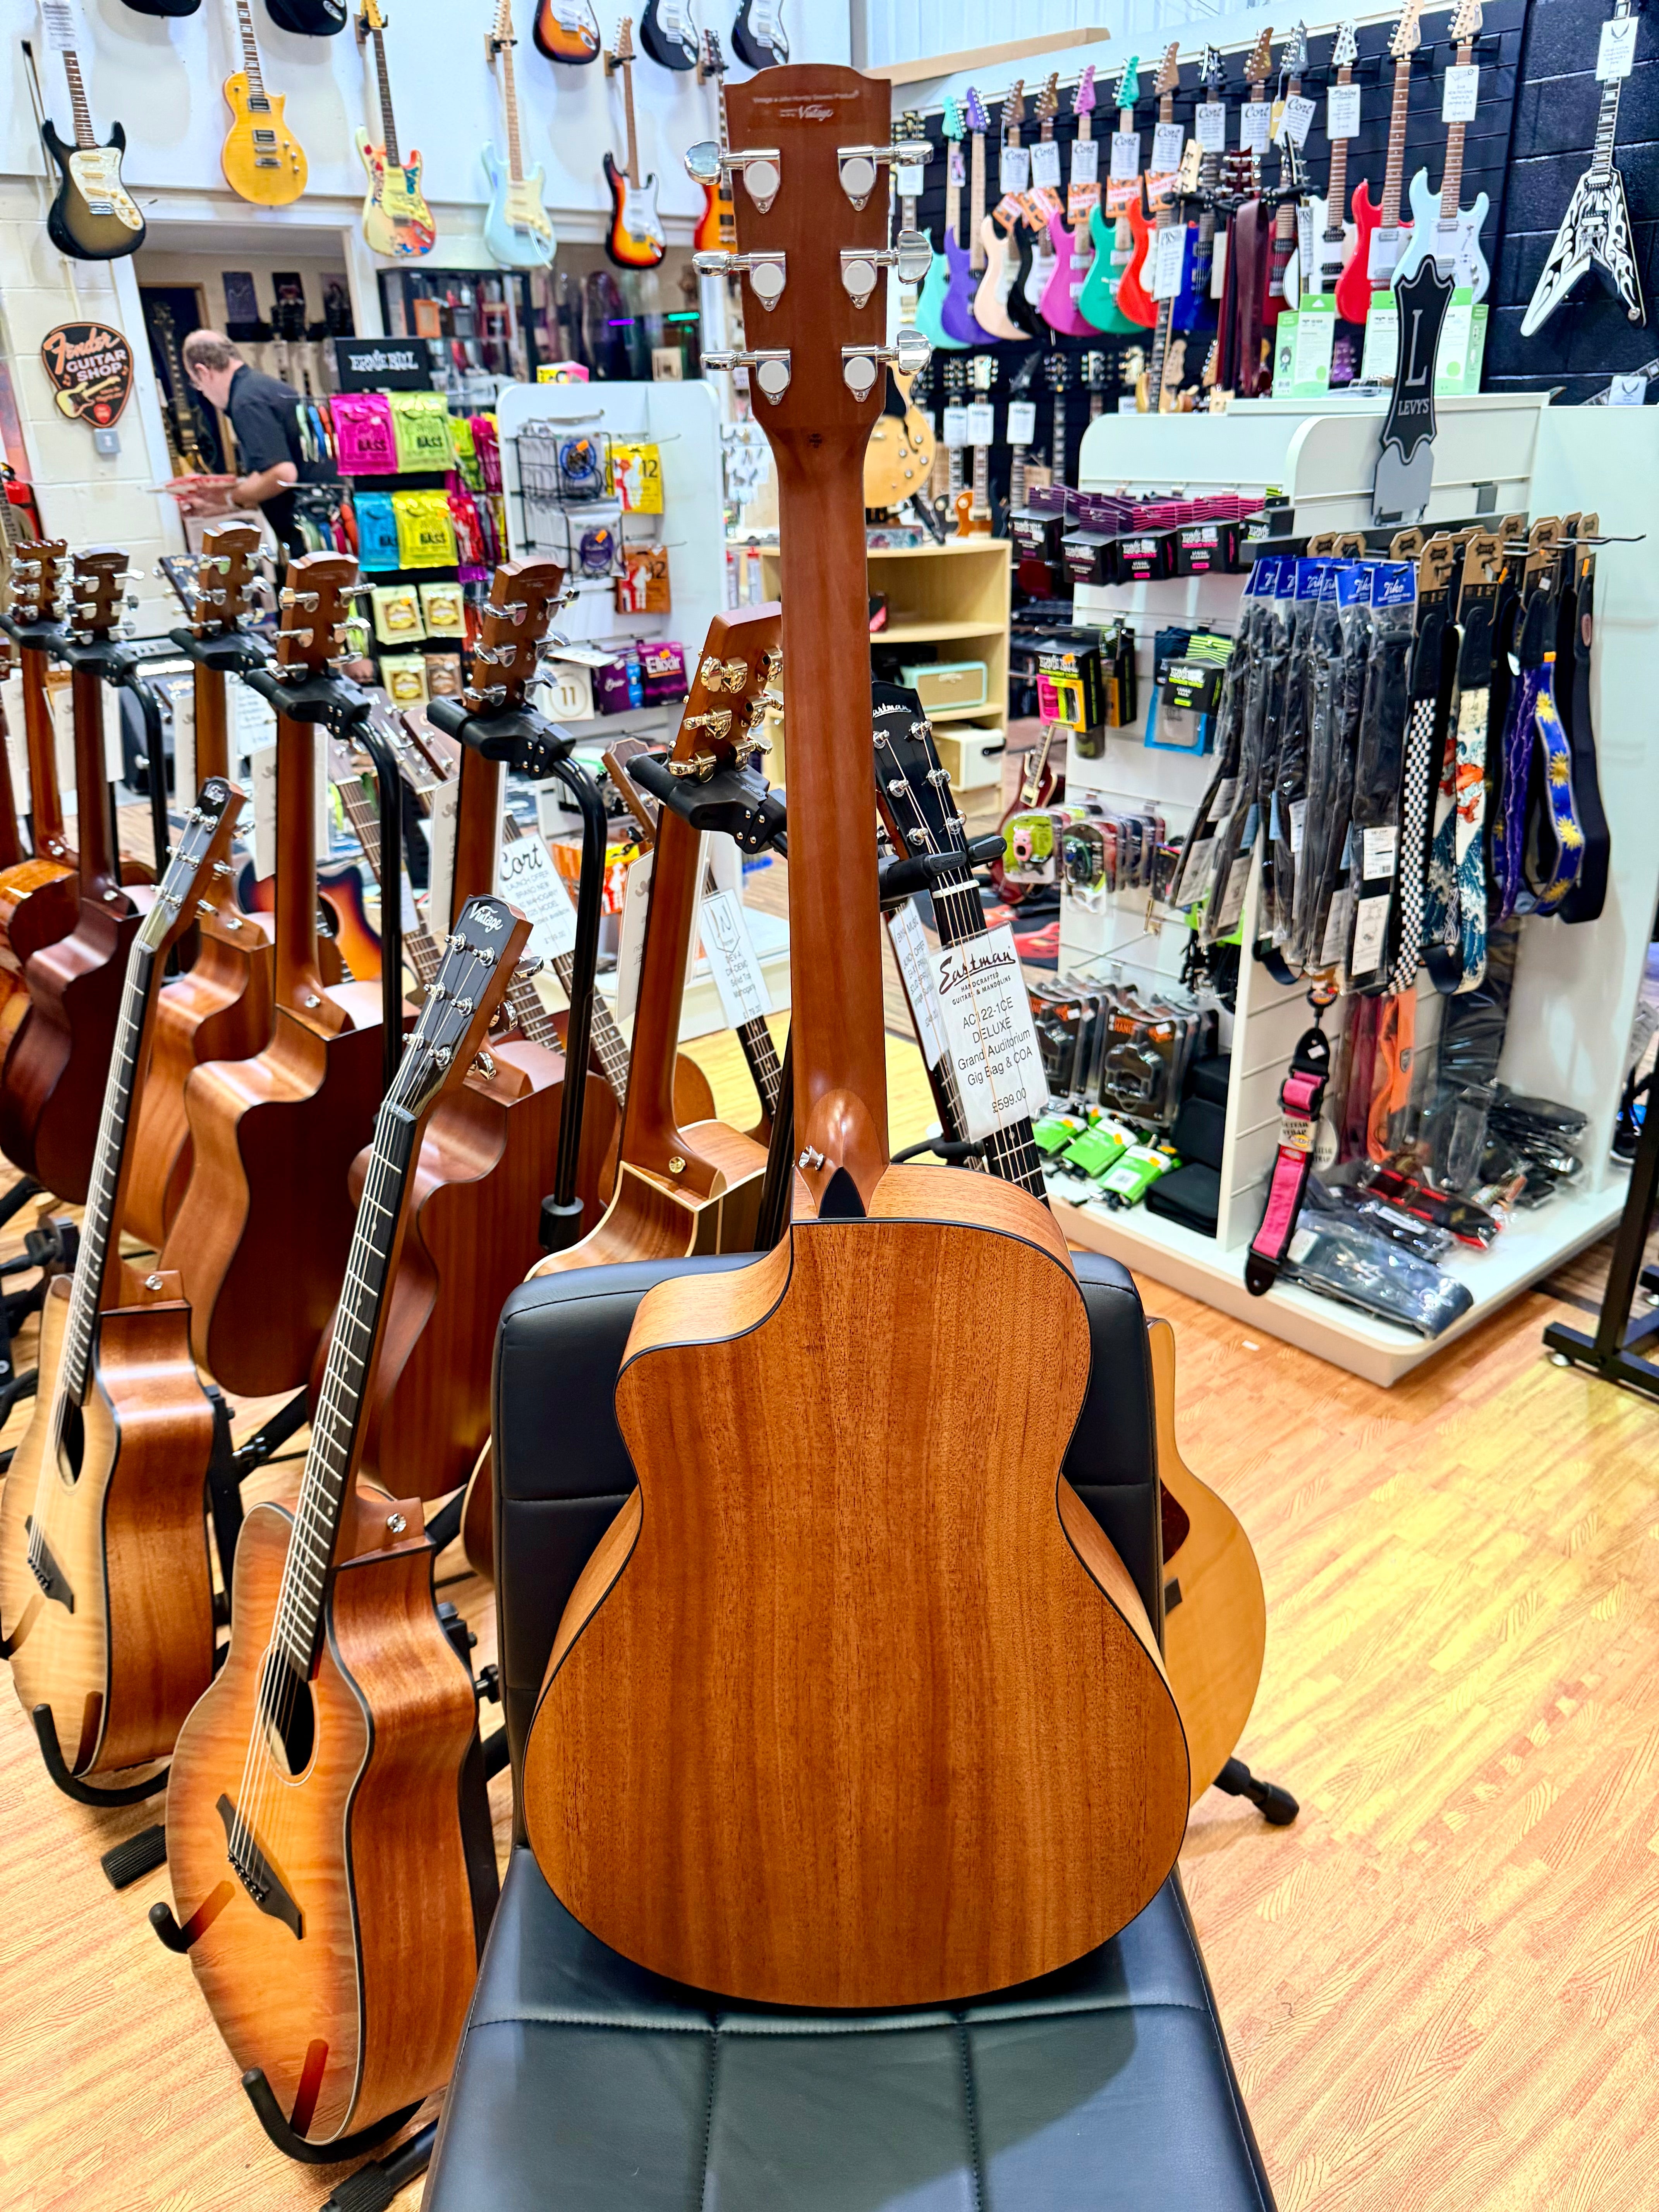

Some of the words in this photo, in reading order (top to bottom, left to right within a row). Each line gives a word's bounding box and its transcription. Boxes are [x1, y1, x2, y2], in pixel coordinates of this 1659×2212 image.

[1288, 98, 1313, 114] Cort
[43, 327, 120, 375] Fender
[1405, 309, 1427, 386] L
[65, 349, 127, 373] GUITAR
[76, 362, 123, 382] SHOP
[358, 439, 386, 452] BASS
[417, 436, 443, 448] BASS
[641, 459, 658, 478] 12
[420, 532, 447, 544] BASS
[651, 561, 666, 579] 12
[646, 655, 681, 674] Elixir
[561, 687, 575, 707] 11
[872, 702, 912, 718] astman
[500, 843, 543, 881] Cort
[469, 902, 503, 933] Vintage
[906, 915, 919, 933] MUSIC
[914, 940, 925, 957] OFFER
[939, 951, 1016, 995] Eastman
[961, 972, 999, 992] HANDCRAFTED
[982, 975, 1011, 993] MANDOLINS
[963, 996, 1014, 1029] AC122-1CE
[972, 1017, 1013, 1044] DELUXE
[958, 1049, 986, 1070] Grand
[988, 1029, 1031, 1057] Auditorium
[968, 1072, 984, 1085] Gig
[984, 1062, 1005, 1078] Bag
[1006, 1056, 1013, 1068] &
[1013, 1046, 1033, 1064] COA
[991, 1087, 1027, 1114] £599.00
